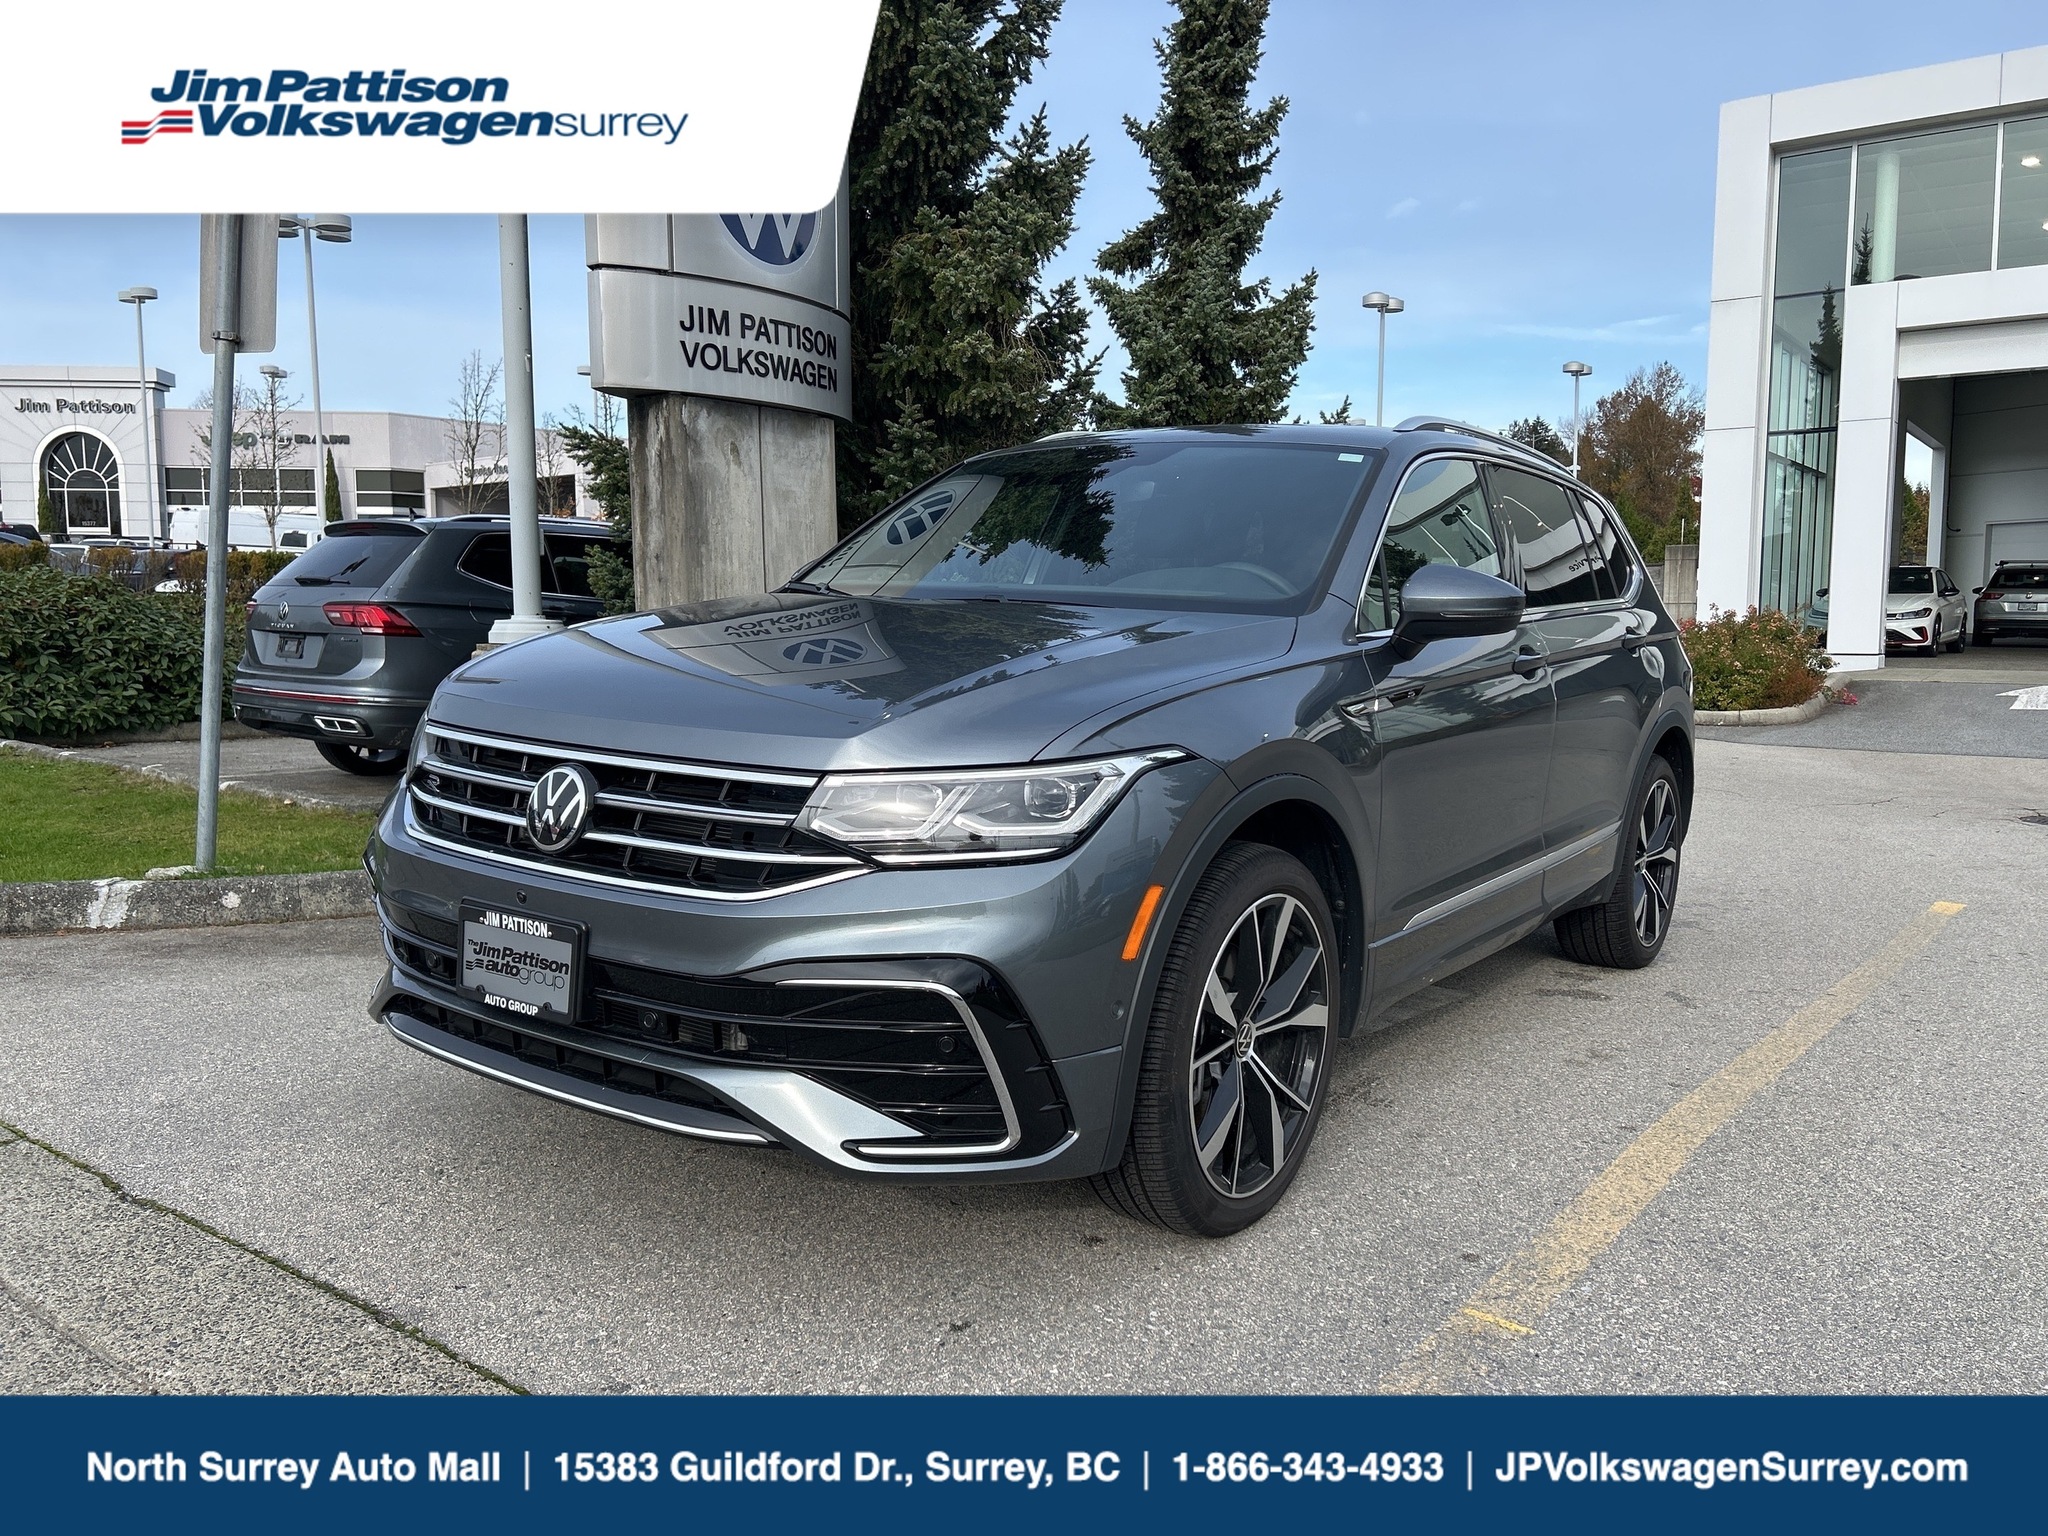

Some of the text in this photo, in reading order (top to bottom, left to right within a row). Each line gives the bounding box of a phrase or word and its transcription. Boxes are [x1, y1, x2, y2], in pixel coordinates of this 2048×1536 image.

[680, 305, 837, 360] JIM PATTISON
[679, 340, 838, 393] VOLKSWAGEN
[15, 398, 136, 414] Jim Pattison
[484, 911, 548, 938] JIM PATTISON
[467, 938, 479, 947] The
[484, 993, 538, 1016] AUTO GROUP
